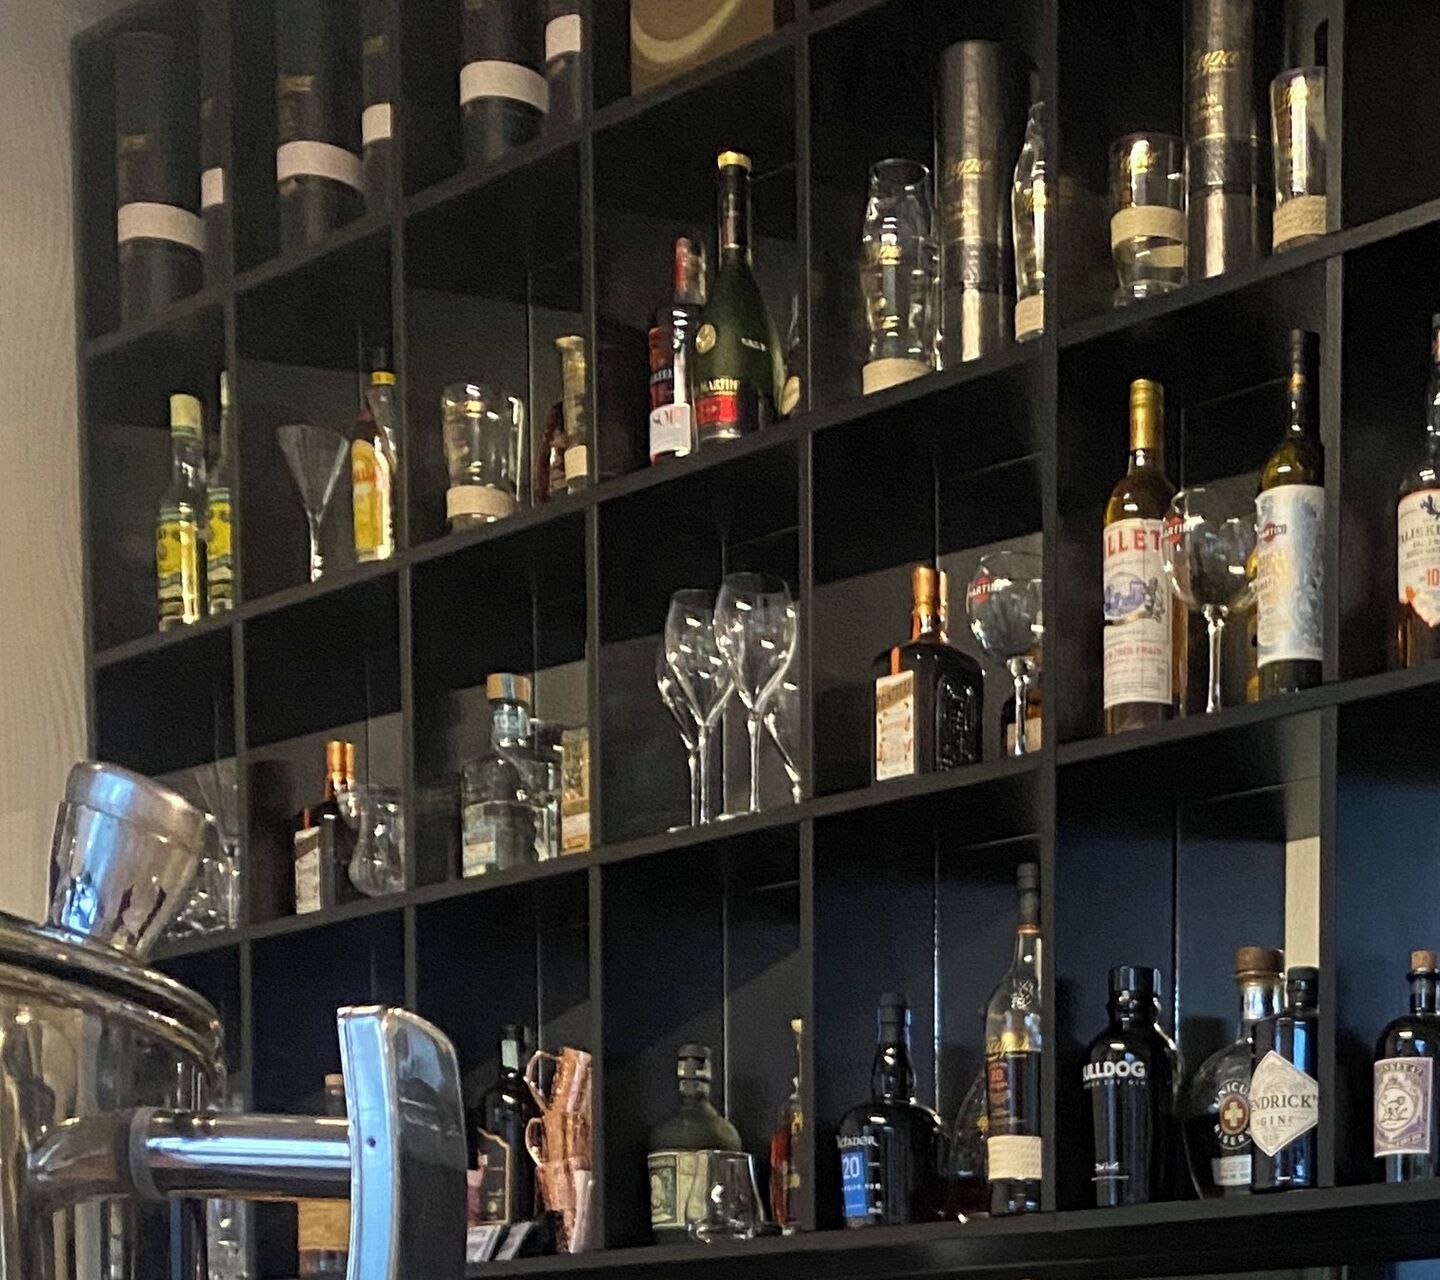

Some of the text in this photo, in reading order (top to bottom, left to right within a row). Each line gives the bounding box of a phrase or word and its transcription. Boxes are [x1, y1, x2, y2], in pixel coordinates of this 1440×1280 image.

[1106, 528, 1164, 558] LLET
[1425, 568, 1440, 588] 10
[1082, 1060, 1146, 1082] ULLDOG
[1214, 1080, 1250, 1107] UNICU
[1214, 1123, 1251, 1146] RISER
[841, 1156, 861, 1179] 20
